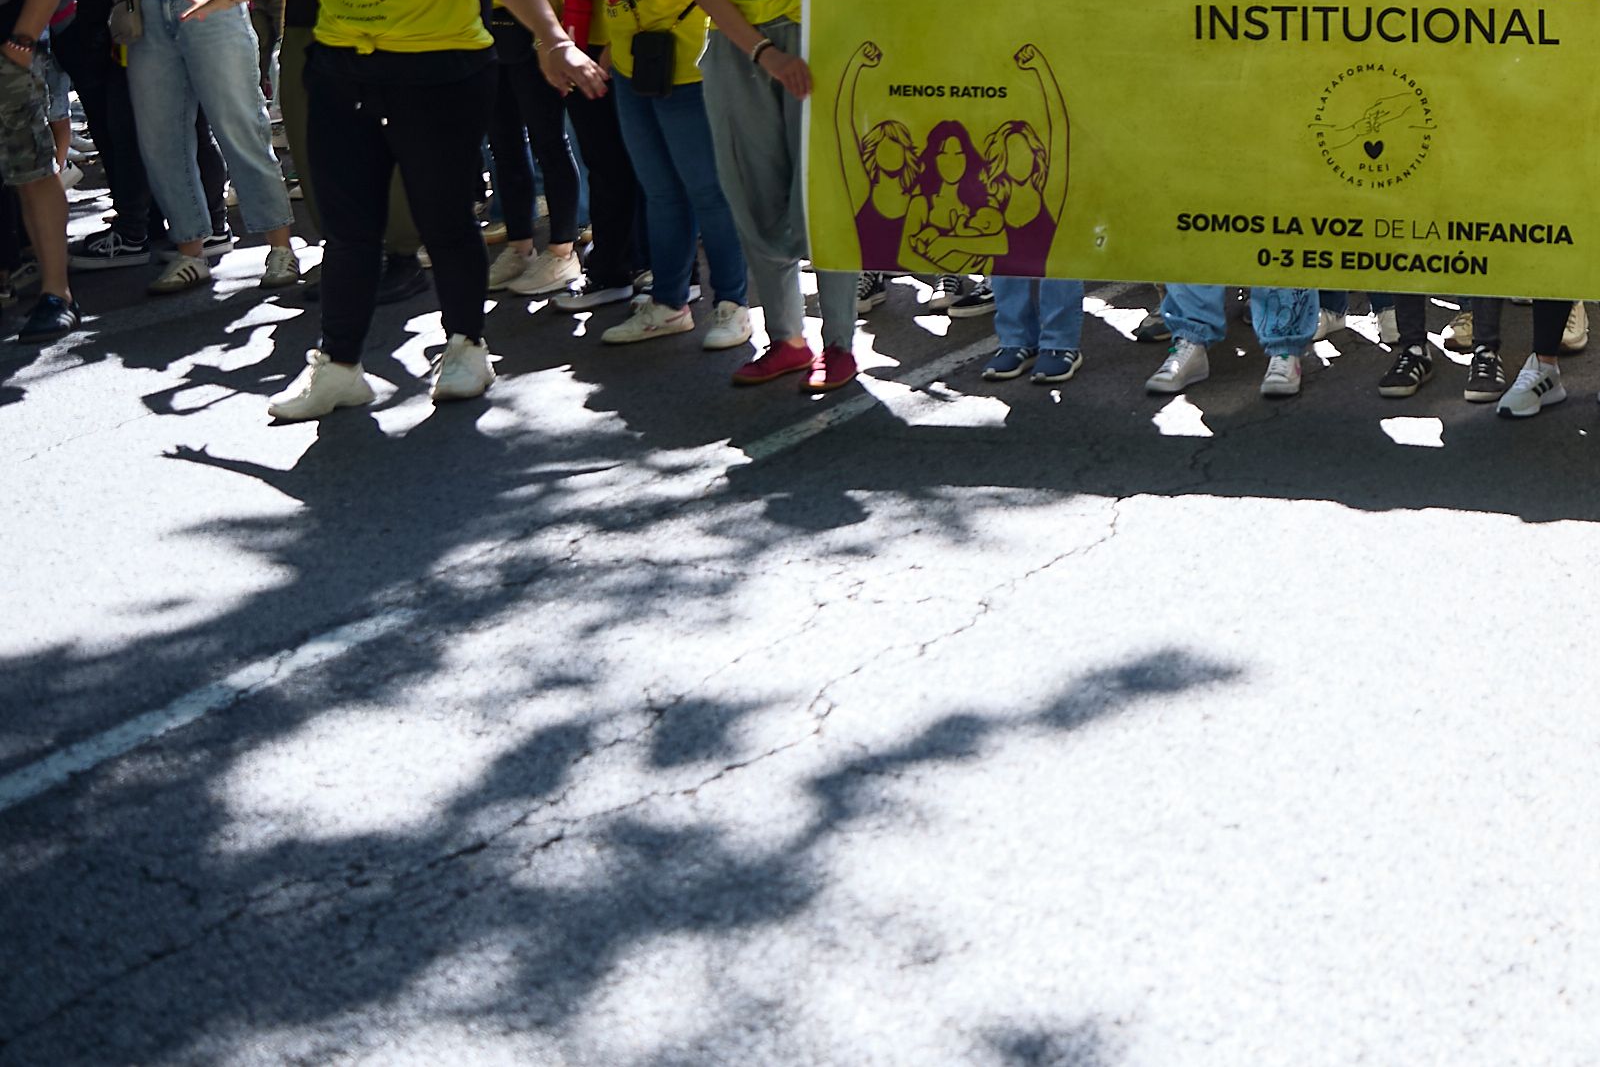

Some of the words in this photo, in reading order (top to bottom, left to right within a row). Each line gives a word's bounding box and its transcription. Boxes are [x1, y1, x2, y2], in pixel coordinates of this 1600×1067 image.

[1195, 4, 1561, 46] INSTITUCIONAL
[889, 84, 946, 99] MENOS
[950, 85, 1009, 99] RATIOS
[1315, 63, 1386, 122] PLATAFORMA
[1392, 68, 1434, 125] LABORAL
[1315, 131, 1364, 188] ESCUELAS
[1370, 133, 1432, 189] INFANTILES
[1358, 162, 1391, 173] PLEI
[1176, 212, 1265, 234] SOMOS
[1271, 215, 1303, 236] LA
[1311, 216, 1364, 238] VOZ
[1374, 218, 1405, 240] DE
[1412, 219, 1442, 242] LA
[1447, 220, 1575, 246] INFANCIA
[1256, 247, 1296, 269] 0-3
[1302, 248, 1334, 270] ES
[1340, 248, 1490, 277] EDUCACIÓN
